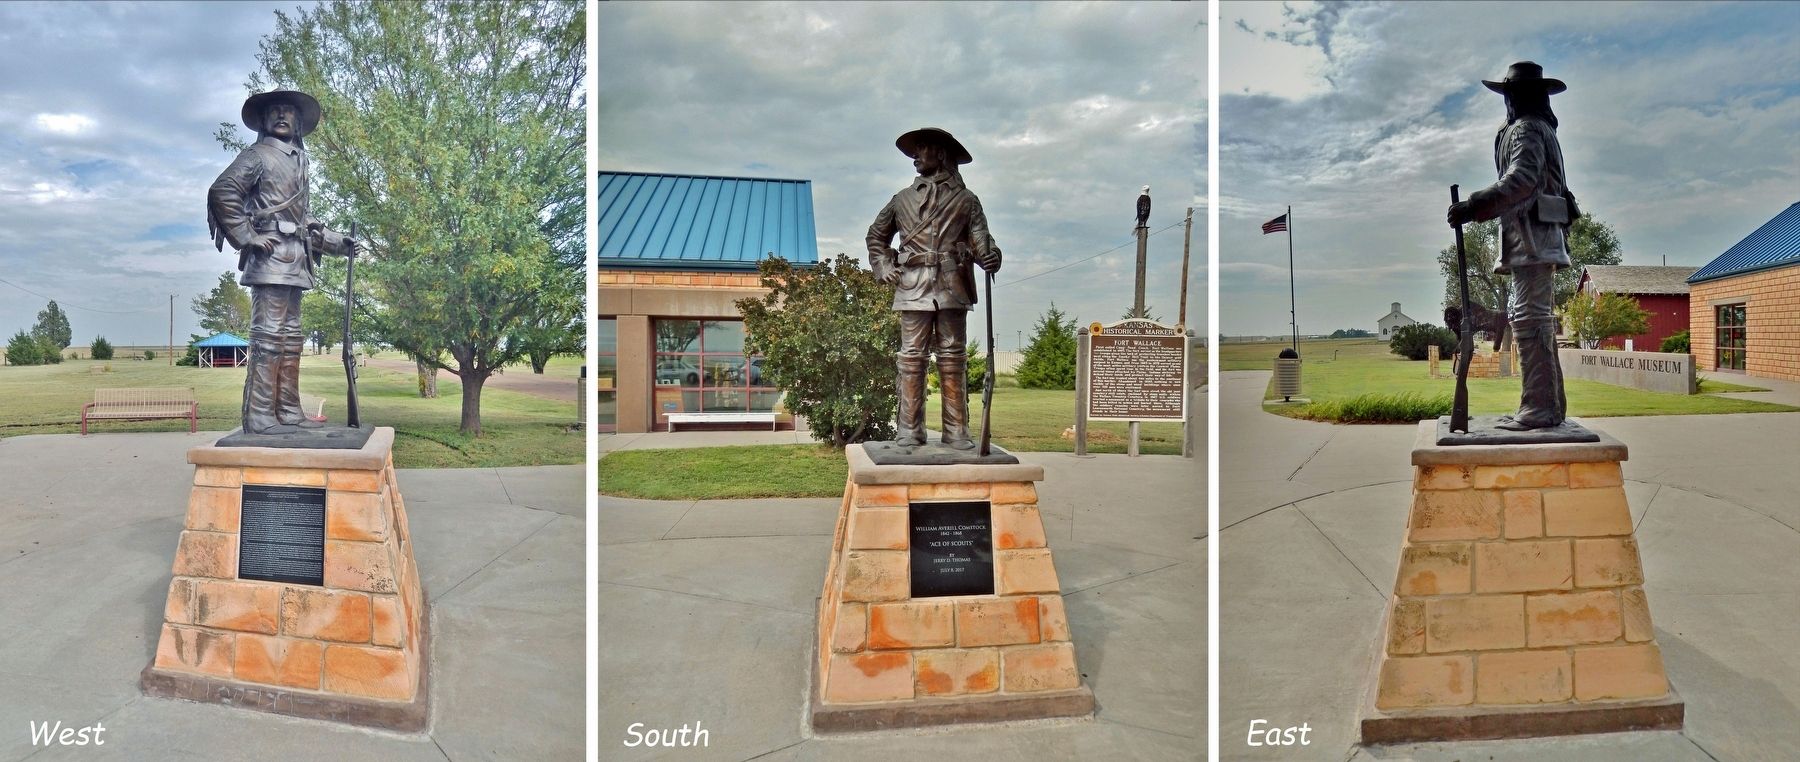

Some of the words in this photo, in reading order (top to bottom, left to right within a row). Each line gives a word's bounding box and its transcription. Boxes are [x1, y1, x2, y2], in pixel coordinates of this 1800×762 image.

[1581, 354, 1597, 365] FORT
[1600, 356, 1634, 369] WALLACE
[1638, 359, 1681, 374] MUSEUM
